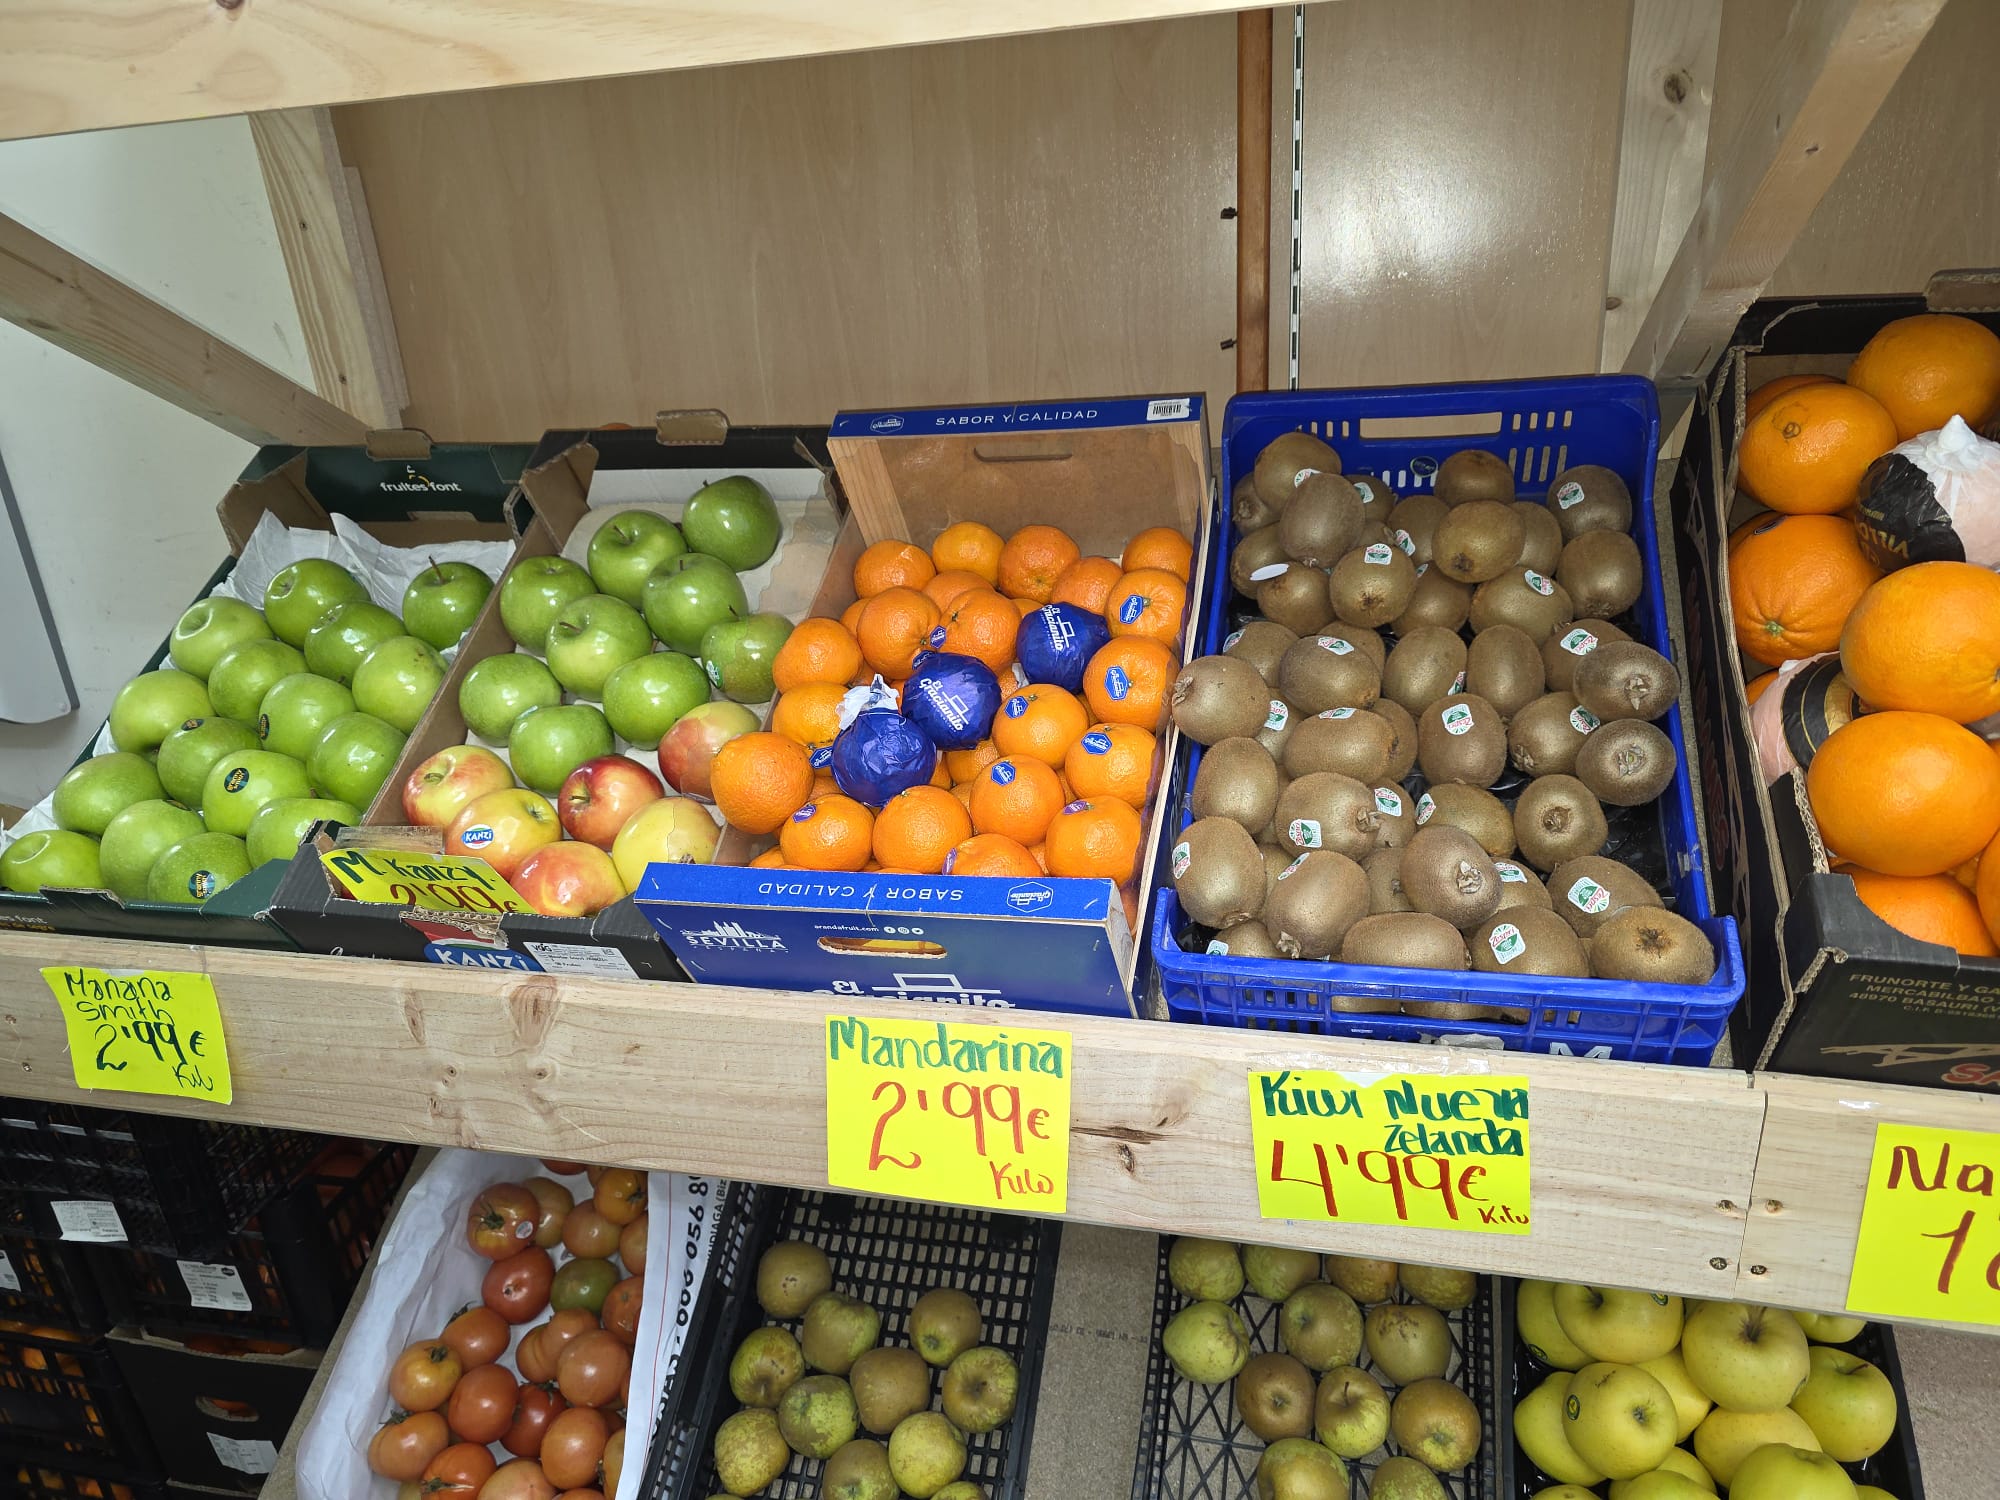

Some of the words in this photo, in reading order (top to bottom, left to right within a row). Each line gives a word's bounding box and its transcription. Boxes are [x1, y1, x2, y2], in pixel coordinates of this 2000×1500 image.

[935, 416, 994, 427] SABOR
[1002, 414, 1012, 424] Y
[1018, 409, 1099, 422] CALIDAD
[380, 482, 428, 492] fruites
[429, 481, 462, 492] font
[919, 678, 964, 731] Gracianito
[758, 882, 855, 898] CALIDAD
[863, 886, 876, 899] Y
[886, 887, 964, 901] SABOR
[686, 935, 787, 949] SEVILLA
[1849, 973, 1953, 991] FRUNORTE
[1958, 983, 1971, 993] Y
[1866, 984, 1995, 1004] MERCABILBAO
[1901, 997, 1980, 1011] BASAURI
[829, 1016, 1064, 1079] Mandarina
[1259, 1070, 1364, 1119] Kiwi
[1383, 1118, 1525, 1157] Zelanda
[687, 1174, 709, 1197] 8
[685, 1204, 706, 1260] 056
